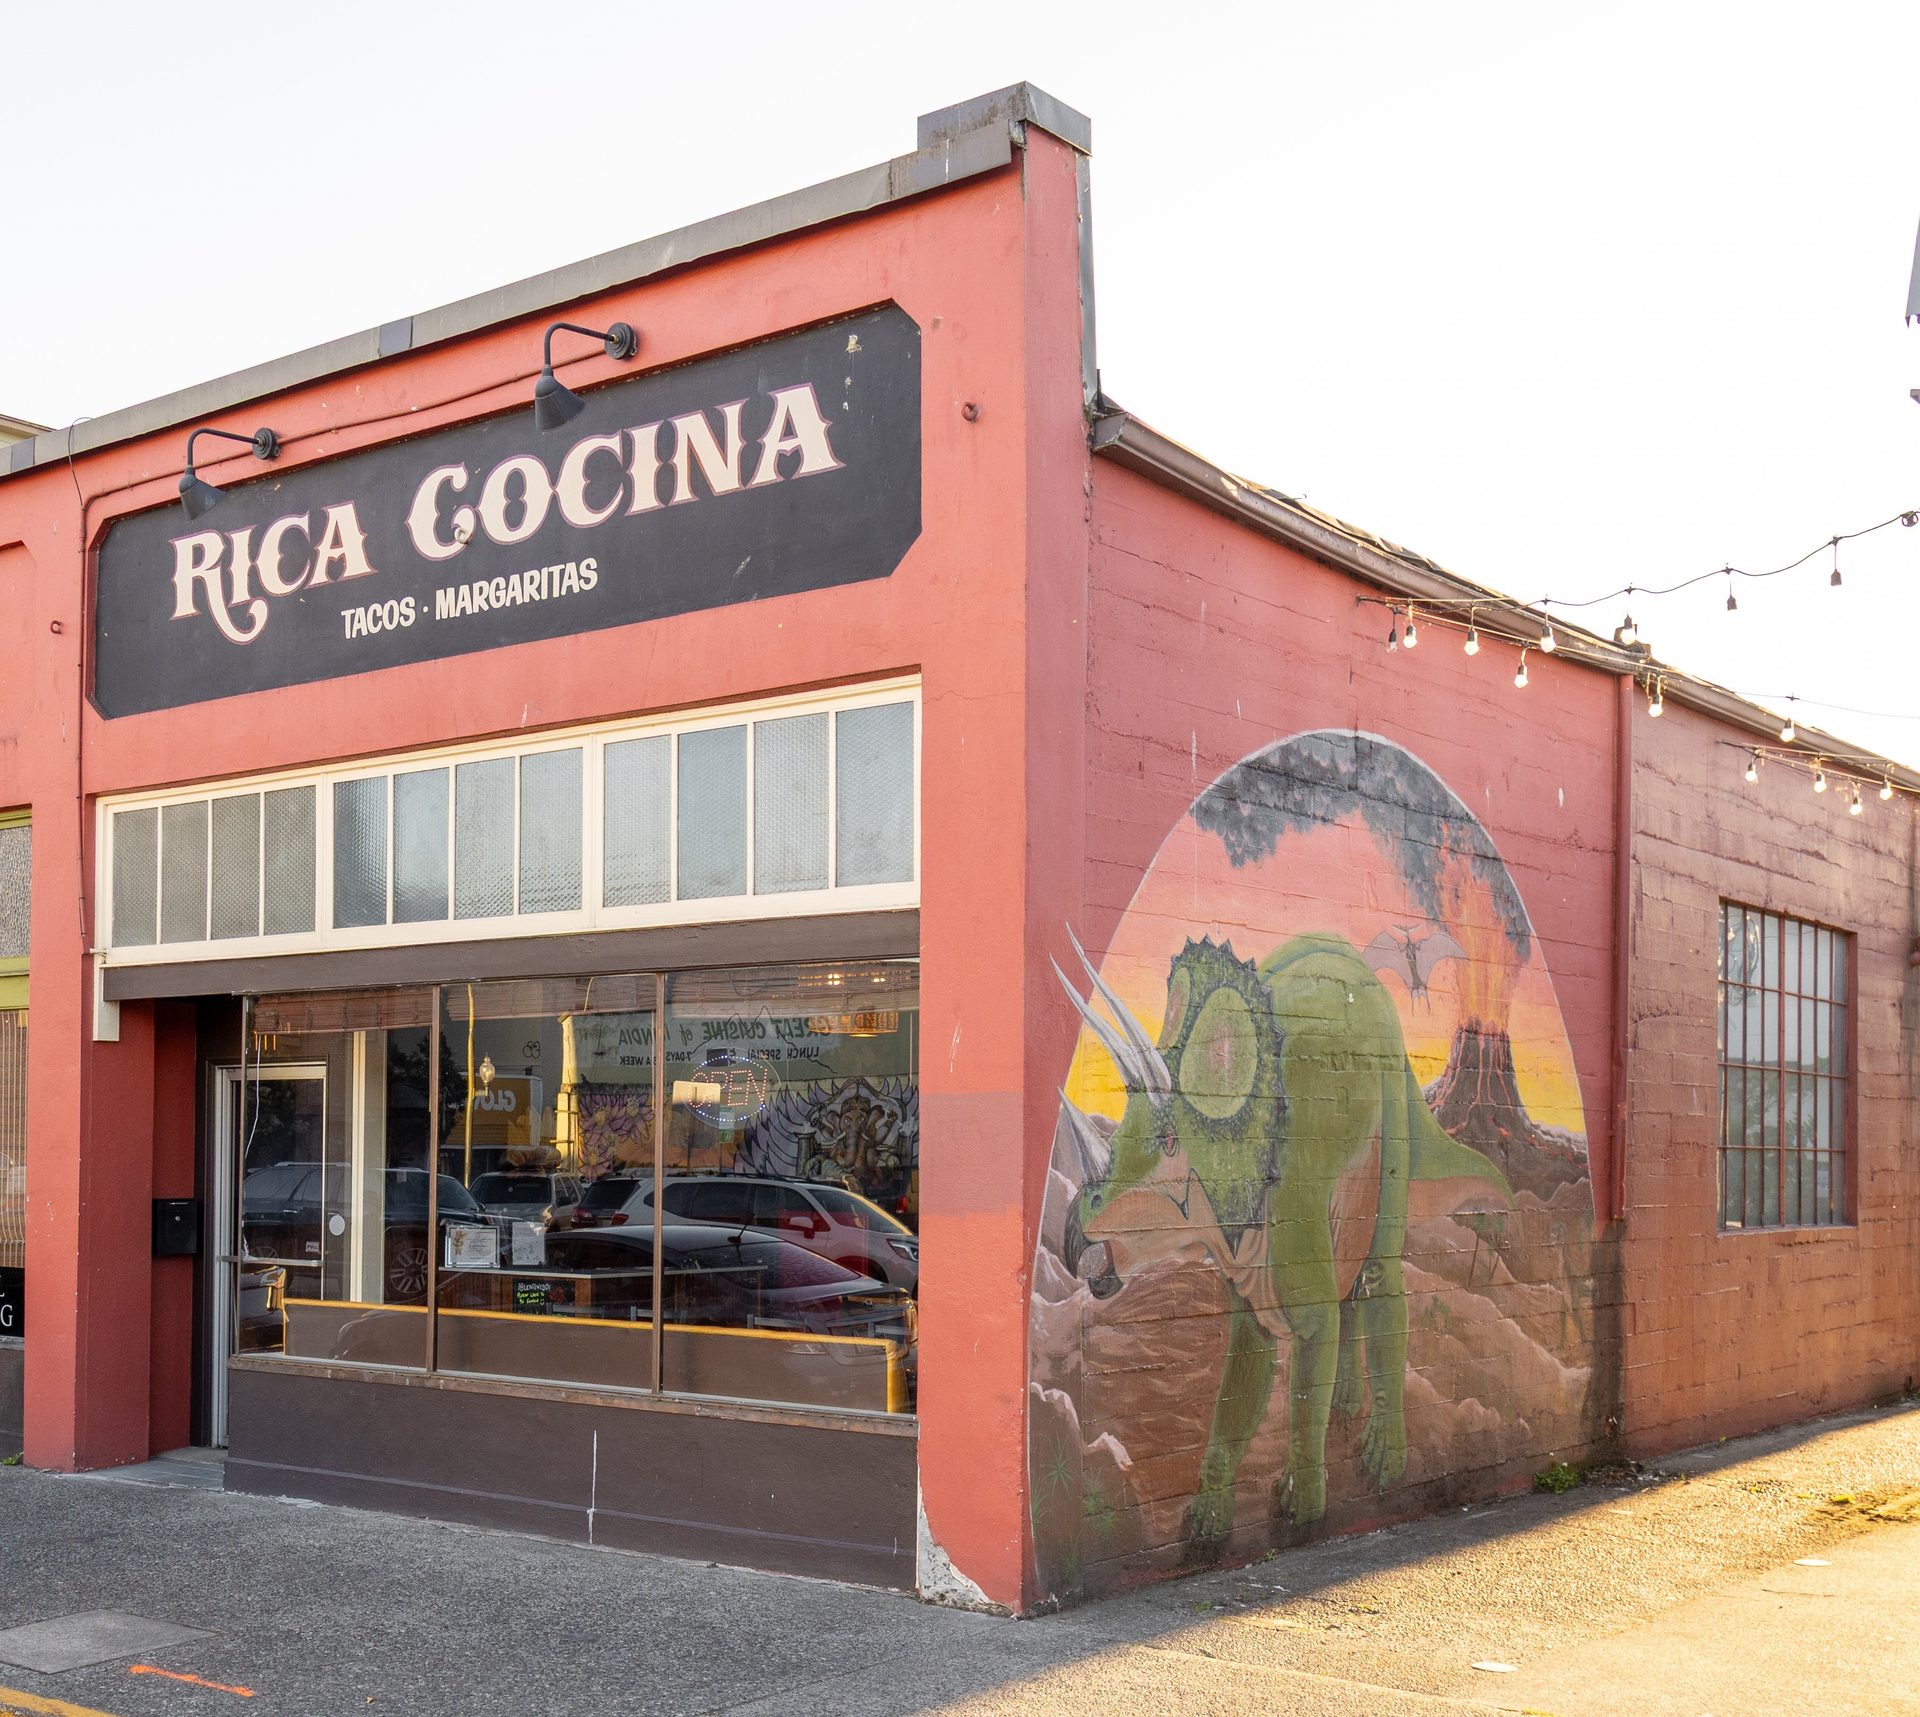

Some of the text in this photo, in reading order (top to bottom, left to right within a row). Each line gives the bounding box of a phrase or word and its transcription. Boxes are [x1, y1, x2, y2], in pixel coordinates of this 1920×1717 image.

[169, 383, 847, 645] RICA COCINA
[341, 557, 598, 640] TACOS MARGARITAS
[688, 1068, 768, 1108] OPEN
